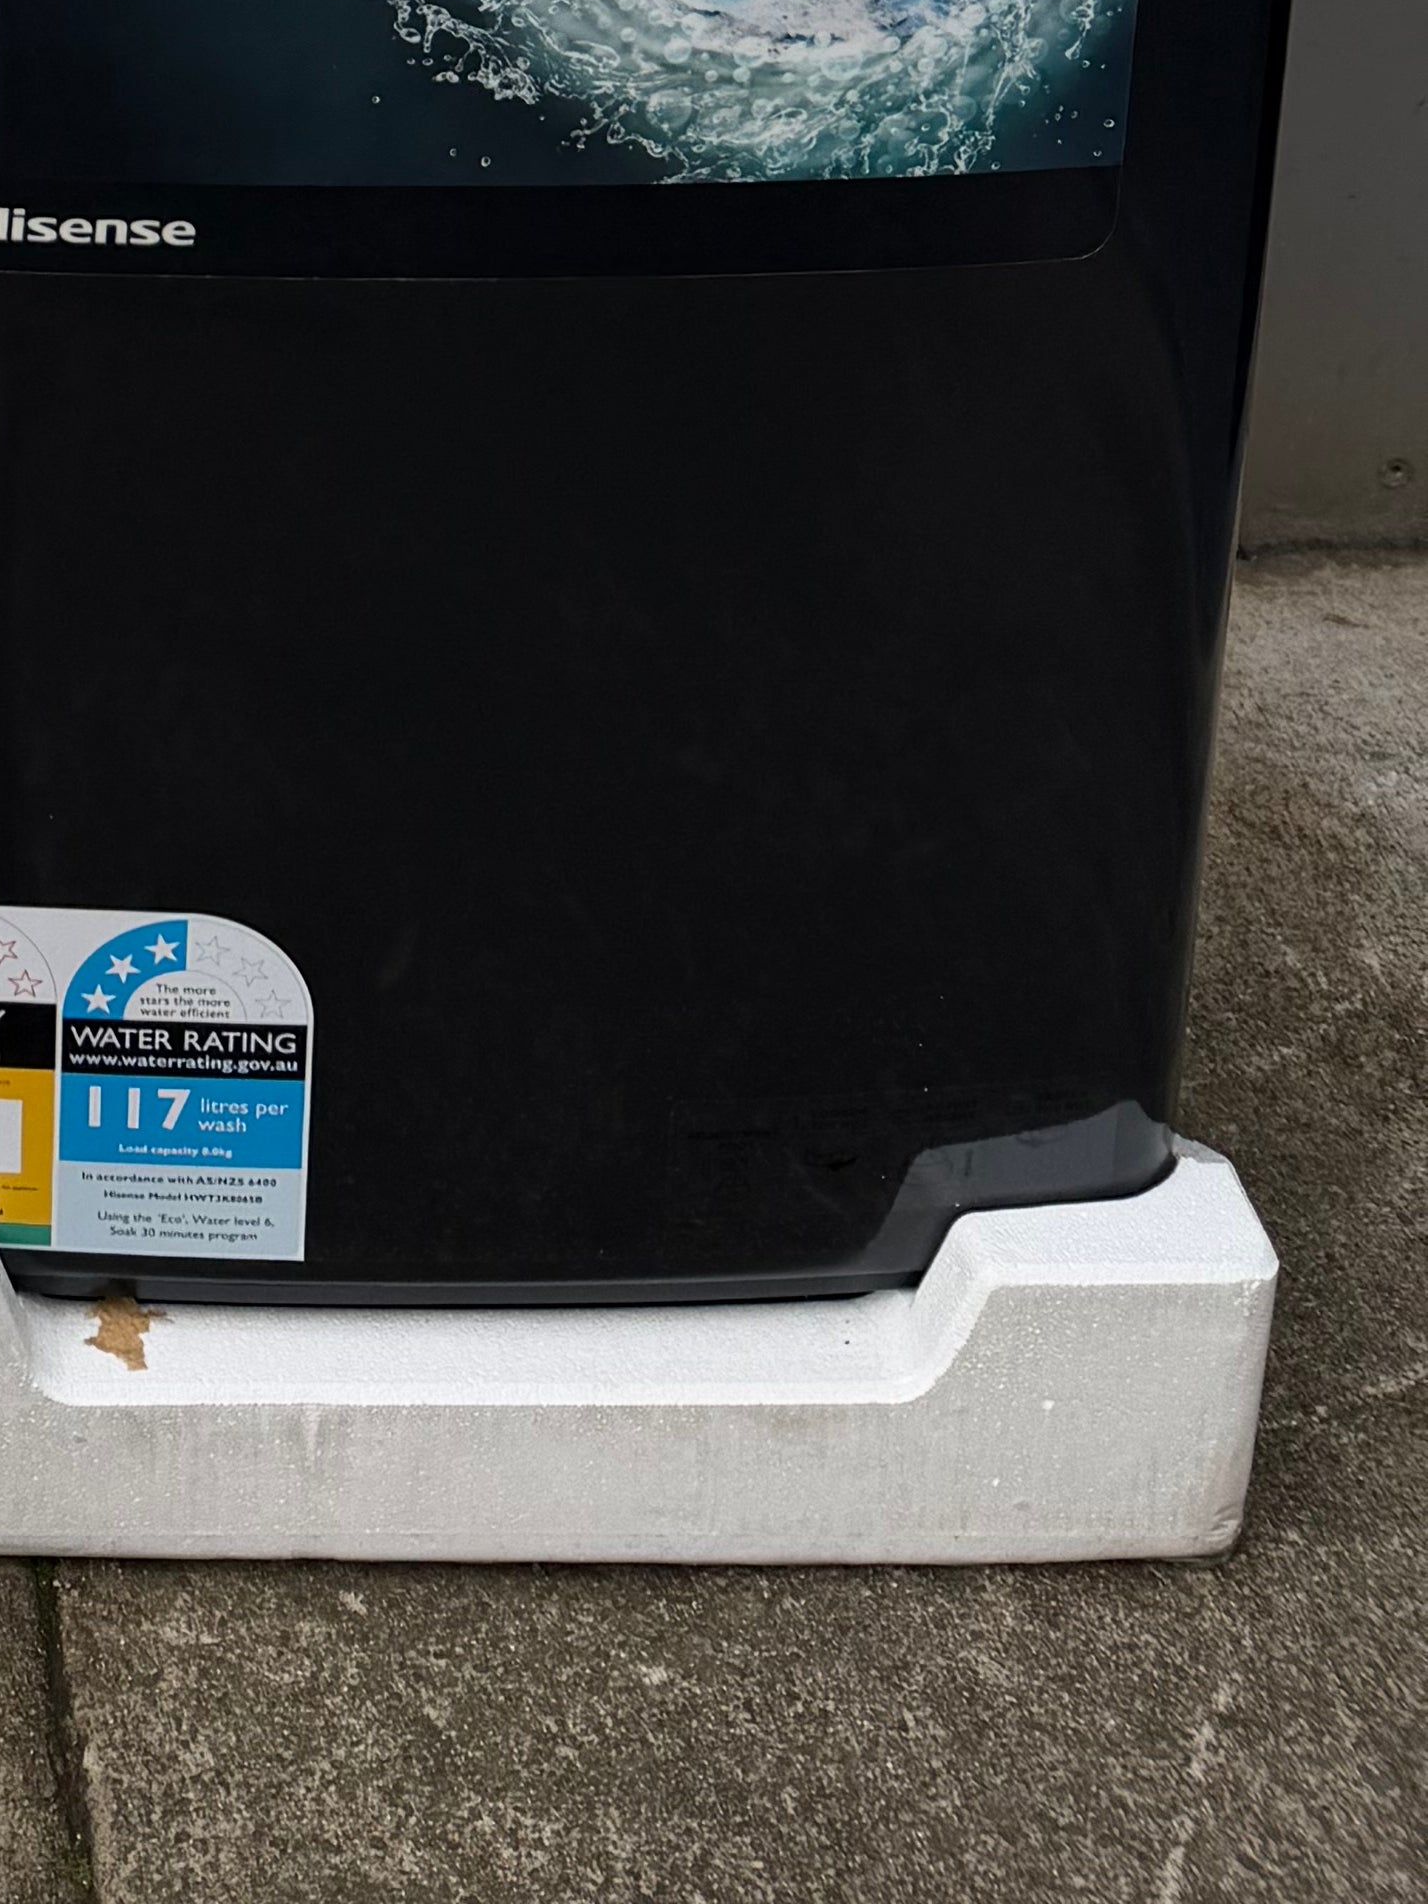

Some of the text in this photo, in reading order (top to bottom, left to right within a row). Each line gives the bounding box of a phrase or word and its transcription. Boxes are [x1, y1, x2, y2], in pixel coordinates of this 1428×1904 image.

[155, 983, 217, 995] The more
[140, 996, 231, 1008] stars the more
[140, 1007, 230, 1020] water efficient
[70, 1025, 297, 1054] WATER RATING
[69, 1052, 298, 1075] www.waterrating.gov.au
[88, 1085, 289, 1131] 117 litres per
[198, 1118, 247, 1133] wash
[118, 1144, 148, 1154] Load
[151, 1145, 198, 1158] capacity
[82, 1171, 93, 1181] In
[96, 1172, 164, 1184] accordance
[167, 1174, 193, 1185] with
[97, 1211, 130, 1224] Using
[133, 1213, 152, 1223] the
[192, 1214, 231, 1226] Water
[234, 1216, 261, 1226] level
[109, 1225, 258, 1242] Soak 30 minutes program
